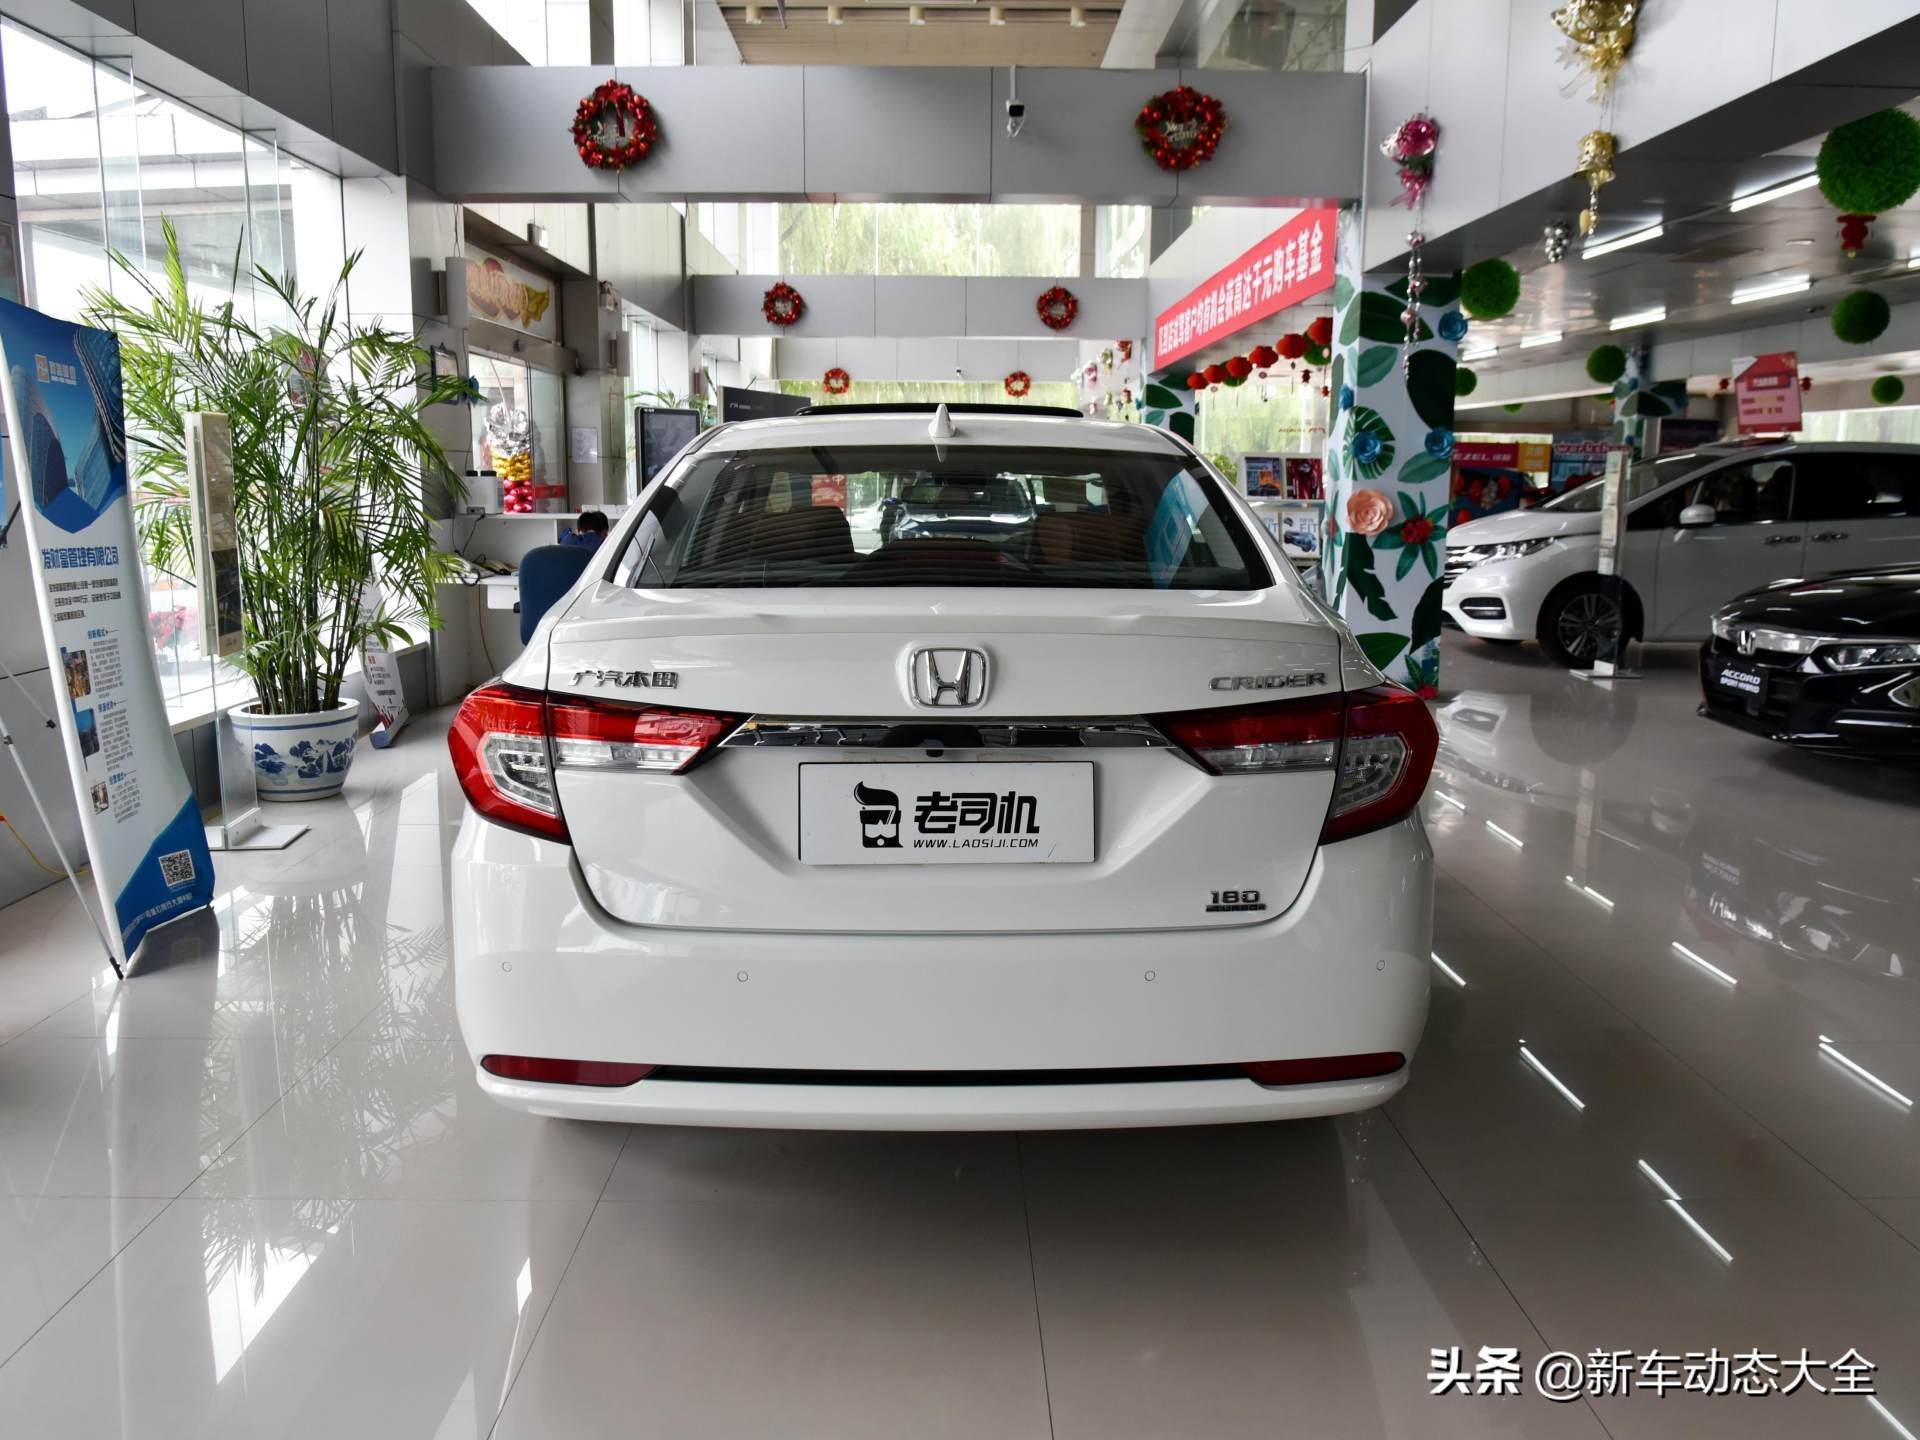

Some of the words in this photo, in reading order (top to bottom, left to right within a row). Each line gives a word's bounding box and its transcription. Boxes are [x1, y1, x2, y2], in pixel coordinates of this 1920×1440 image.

[568, 670, 679, 688] 广汽本田
[1208, 672, 1327, 691] CRIDER
[1721, 669, 1761, 685] ACCORD
[913, 791, 1041, 834] 老司机
[913, 839, 1039, 848] WWW.LAOSIJI.COM
[1210, 890, 1260, 904] 180
